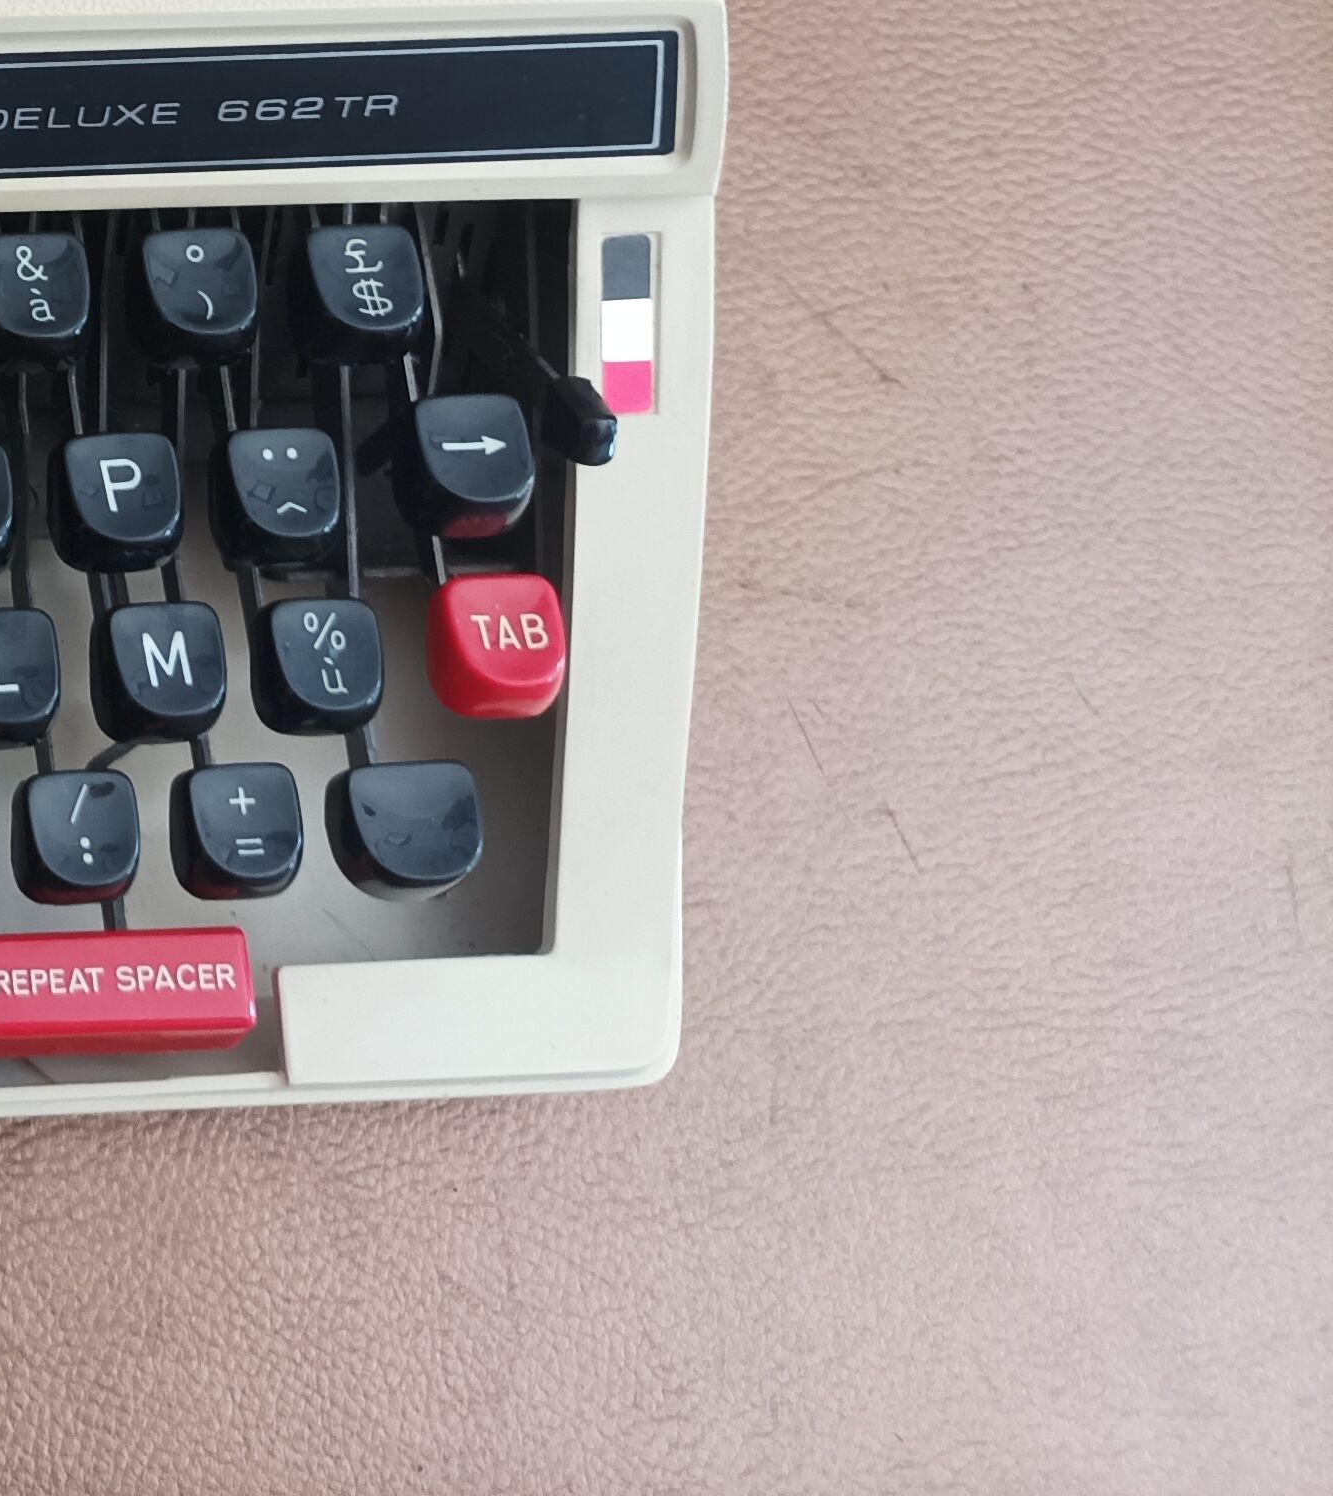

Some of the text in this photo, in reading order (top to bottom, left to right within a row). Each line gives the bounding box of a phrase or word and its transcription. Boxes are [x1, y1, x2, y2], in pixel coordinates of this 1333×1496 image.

[15, 245, 48, 282] &
[344, 238, 383, 273] £
[29, 287, 56, 322] à
[197, 290, 214, 320] )
[352, 277, 393, 317] $
[99, 458, 142, 512] P
[303, 611, 347, 651] %
[470, 612, 550, 652] TAB
[142, 630, 193, 688] M
[70, 783, 88, 825] /
[228, 786, 256, 815] +
[79, 836, 94, 864] :
[235, 837, 265, 856] =
[115, 963, 237, 992] SPACER
